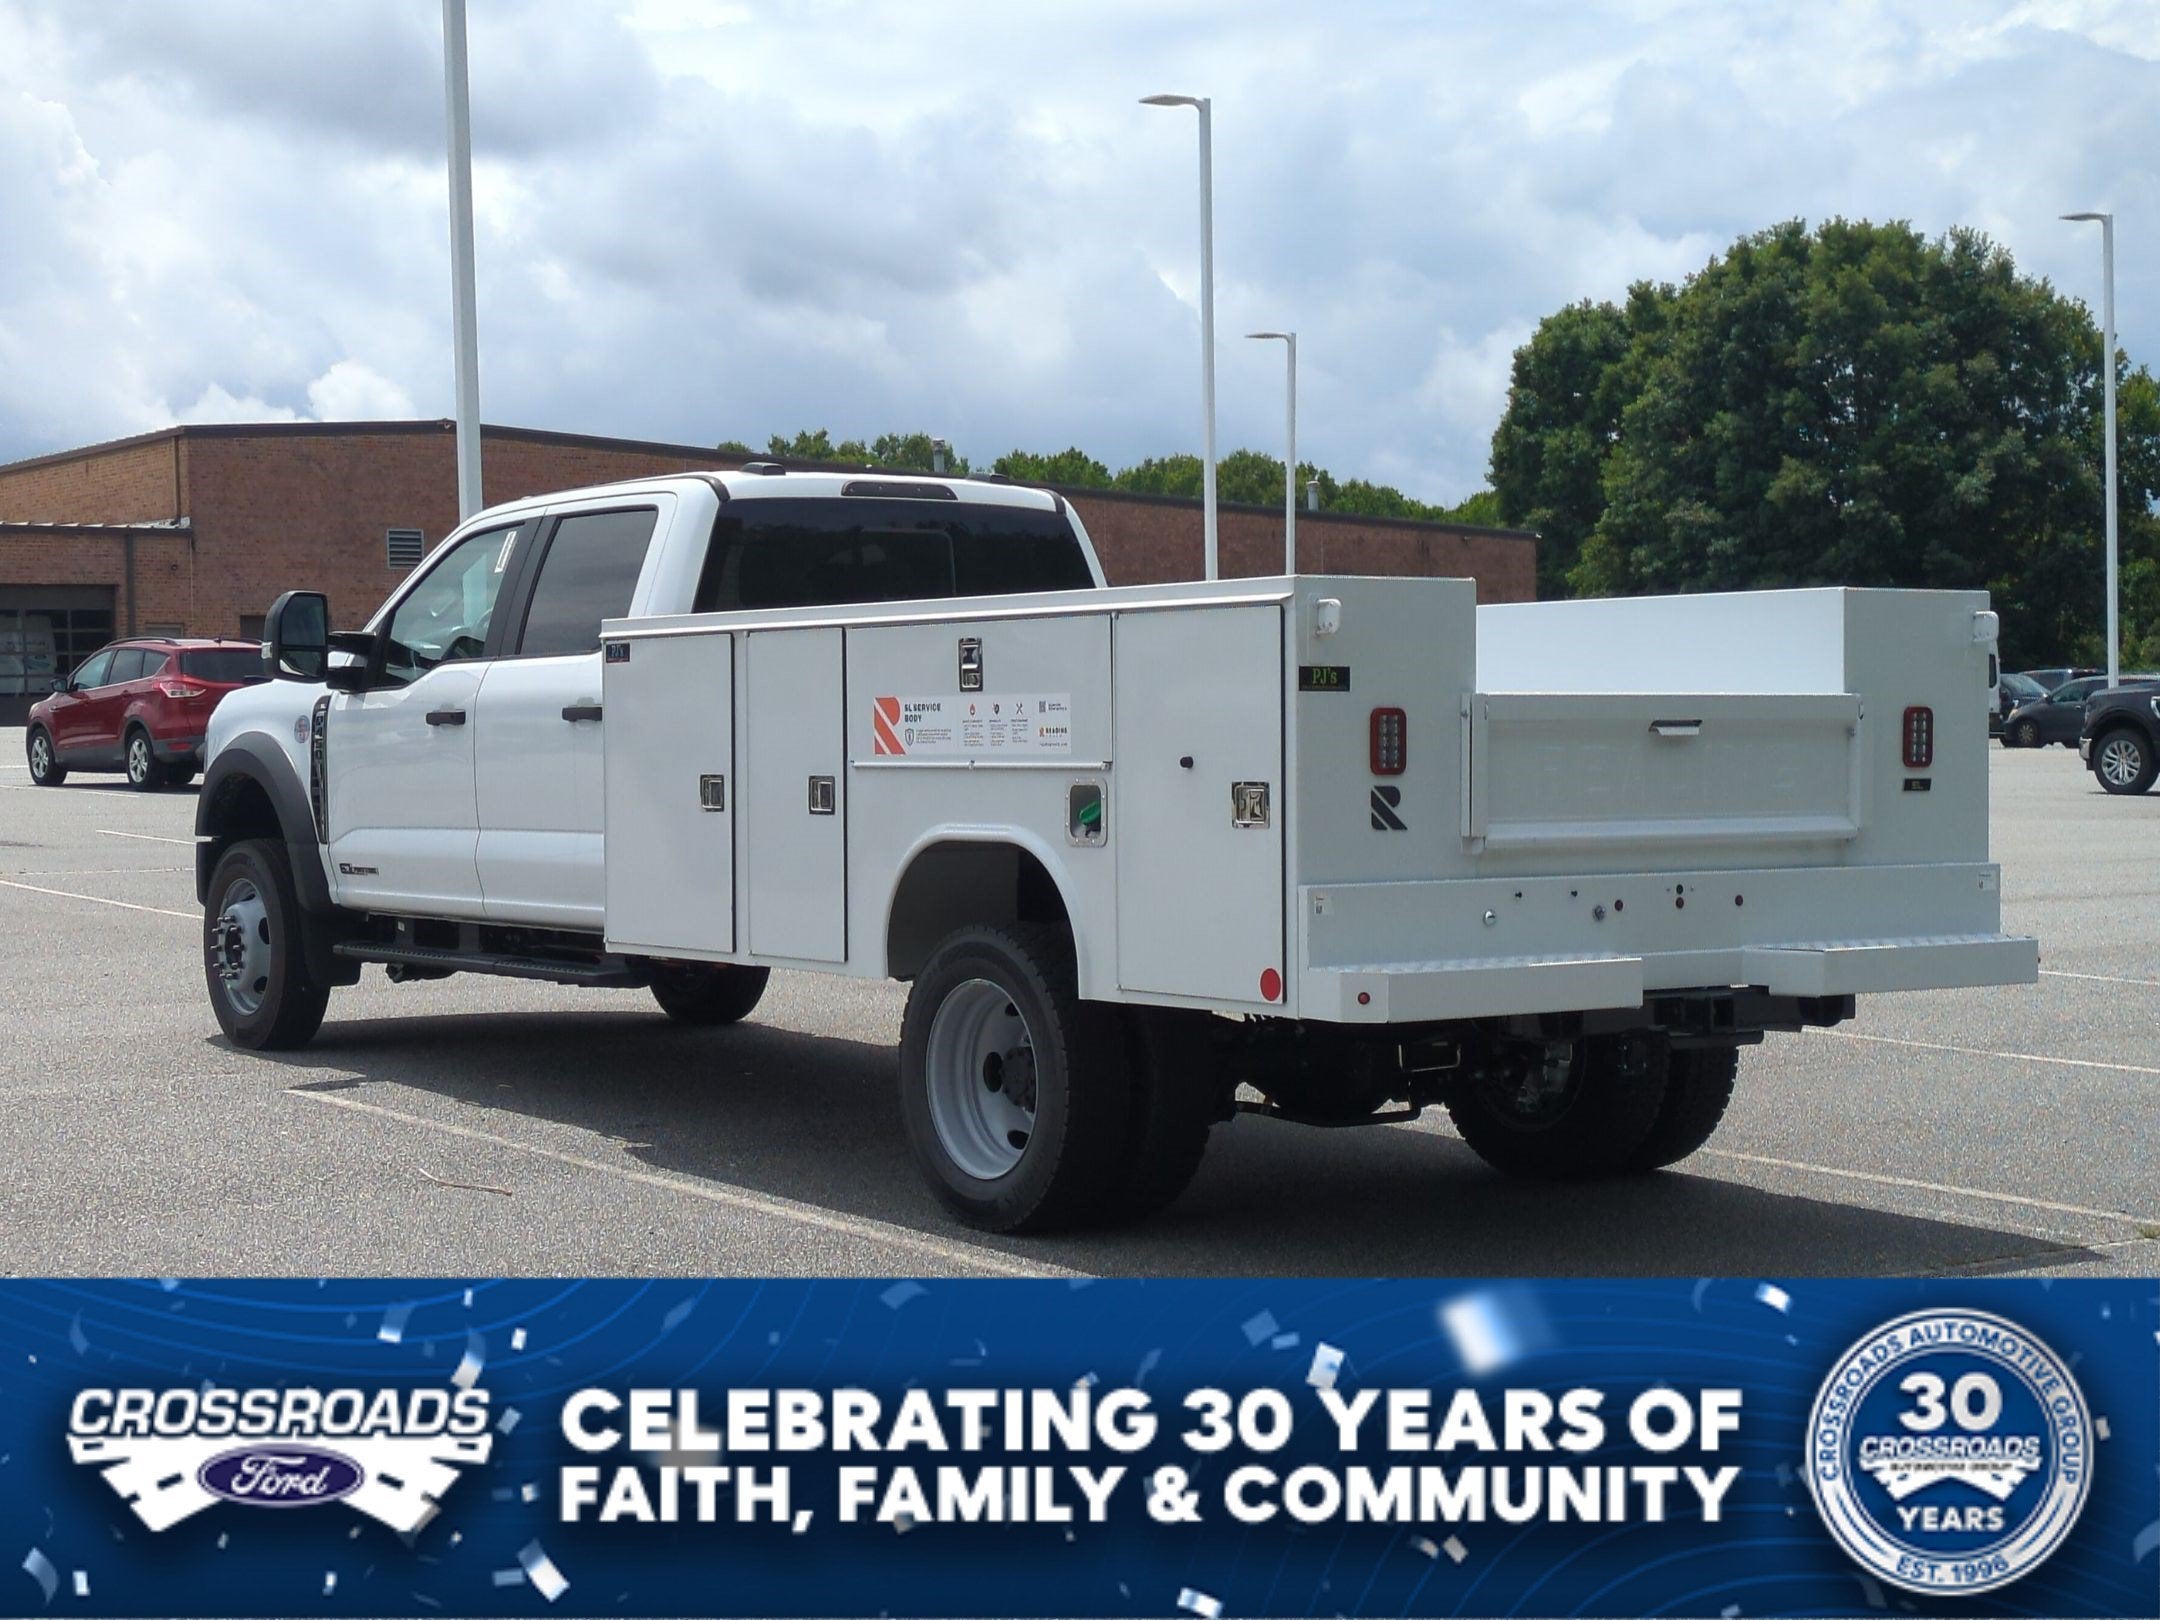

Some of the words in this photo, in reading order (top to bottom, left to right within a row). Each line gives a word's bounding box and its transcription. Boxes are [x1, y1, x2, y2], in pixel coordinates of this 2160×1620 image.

[1312, 667, 1337, 685] PJ's
[913, 703, 941, 712] SERVICE
[904, 714, 922, 723] BODY
